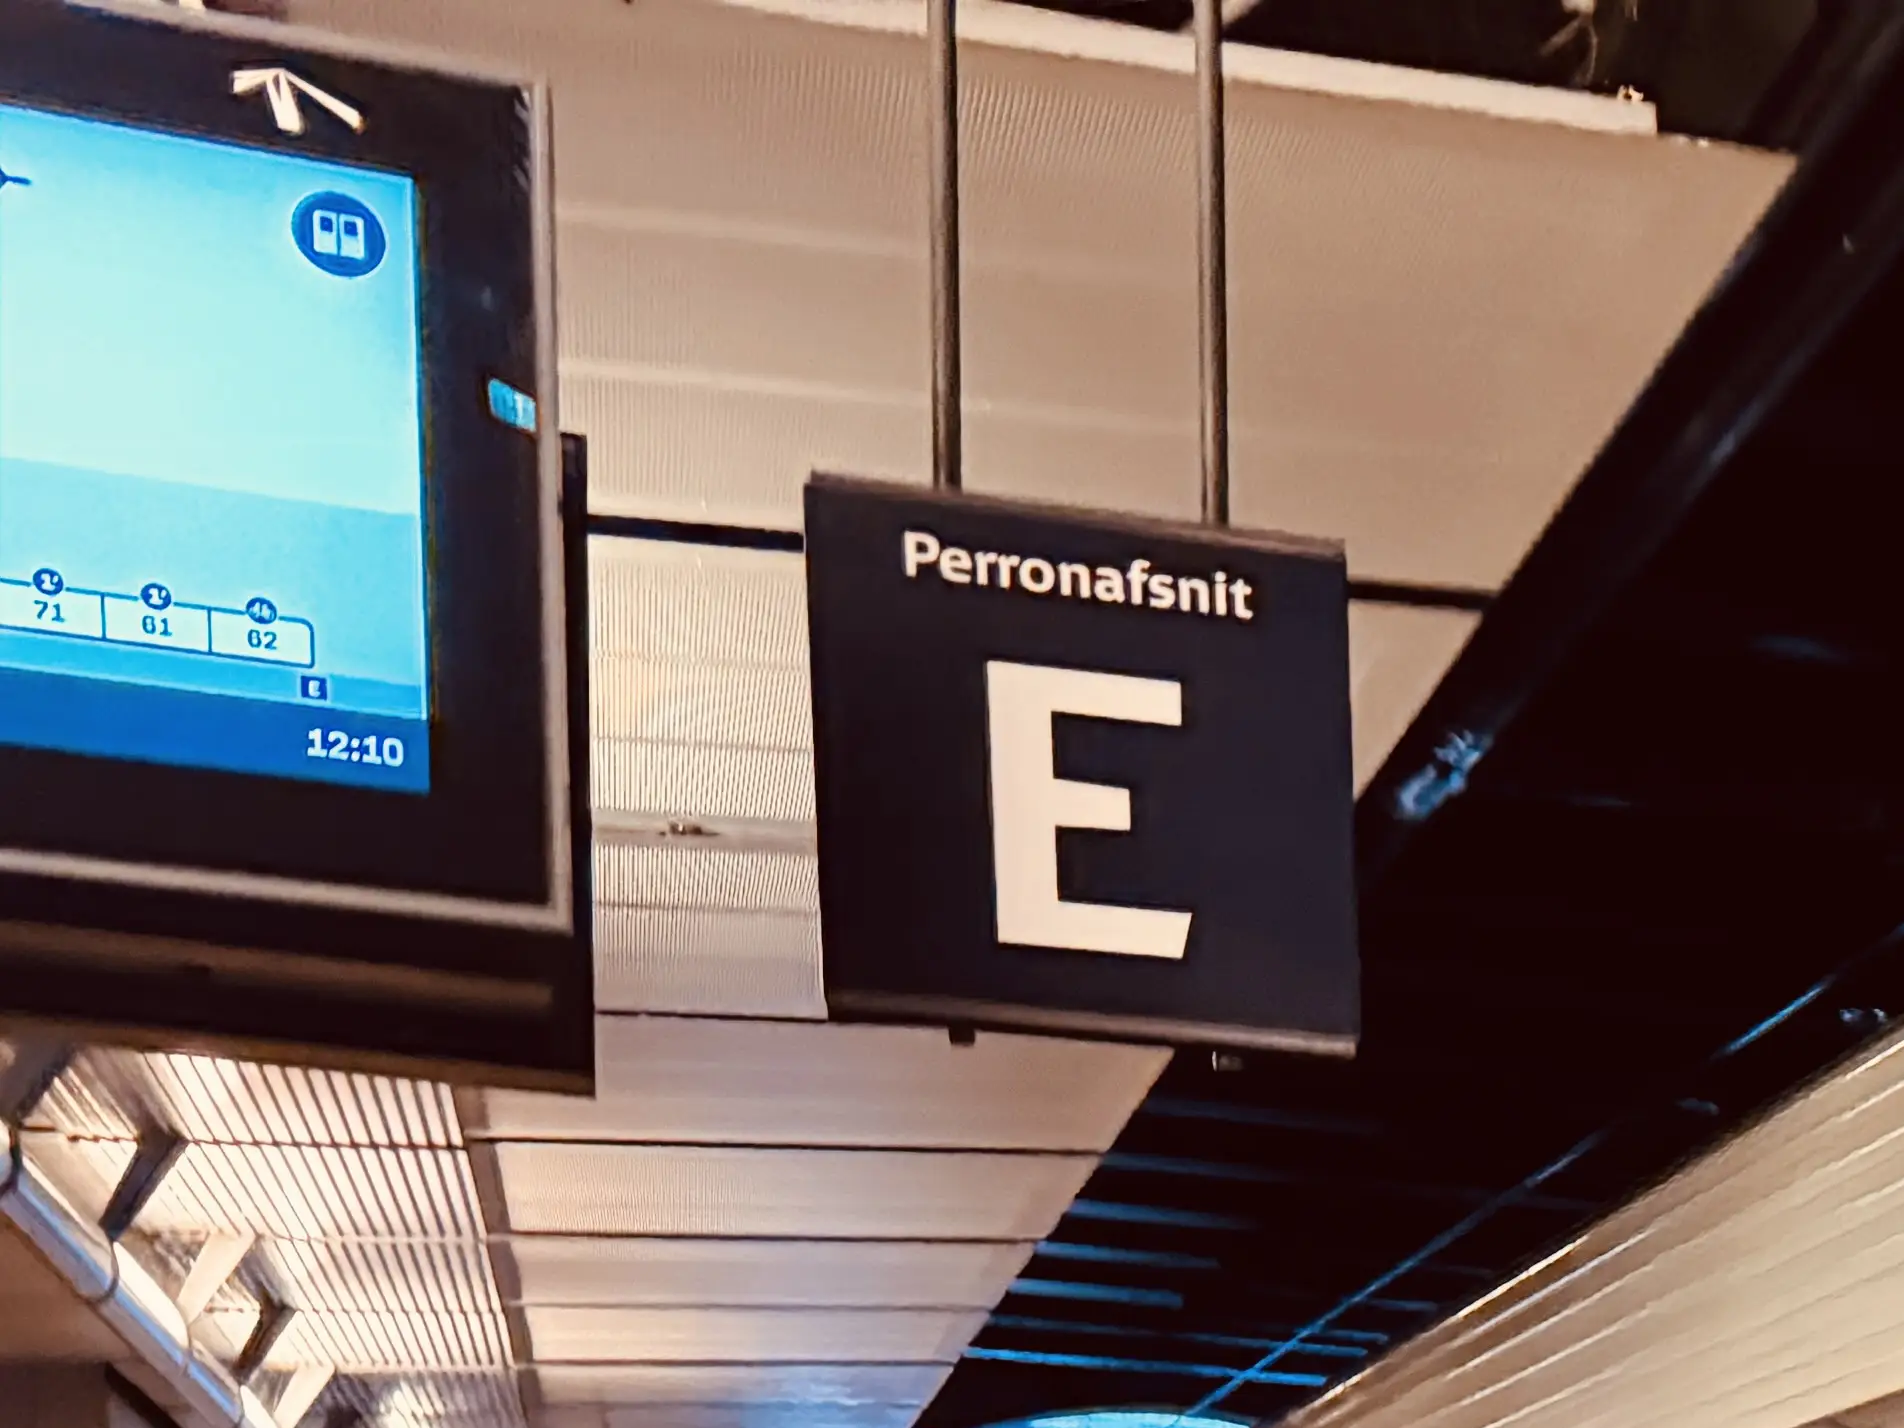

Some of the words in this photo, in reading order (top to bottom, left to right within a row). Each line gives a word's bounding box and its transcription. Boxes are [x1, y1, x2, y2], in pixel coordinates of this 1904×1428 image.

[902, 530, 1254, 620] Perronafsnit
[33, 600, 65, 623] 71
[306, 727, 404, 768] 12:10
[986, 660, 1193, 960] E
